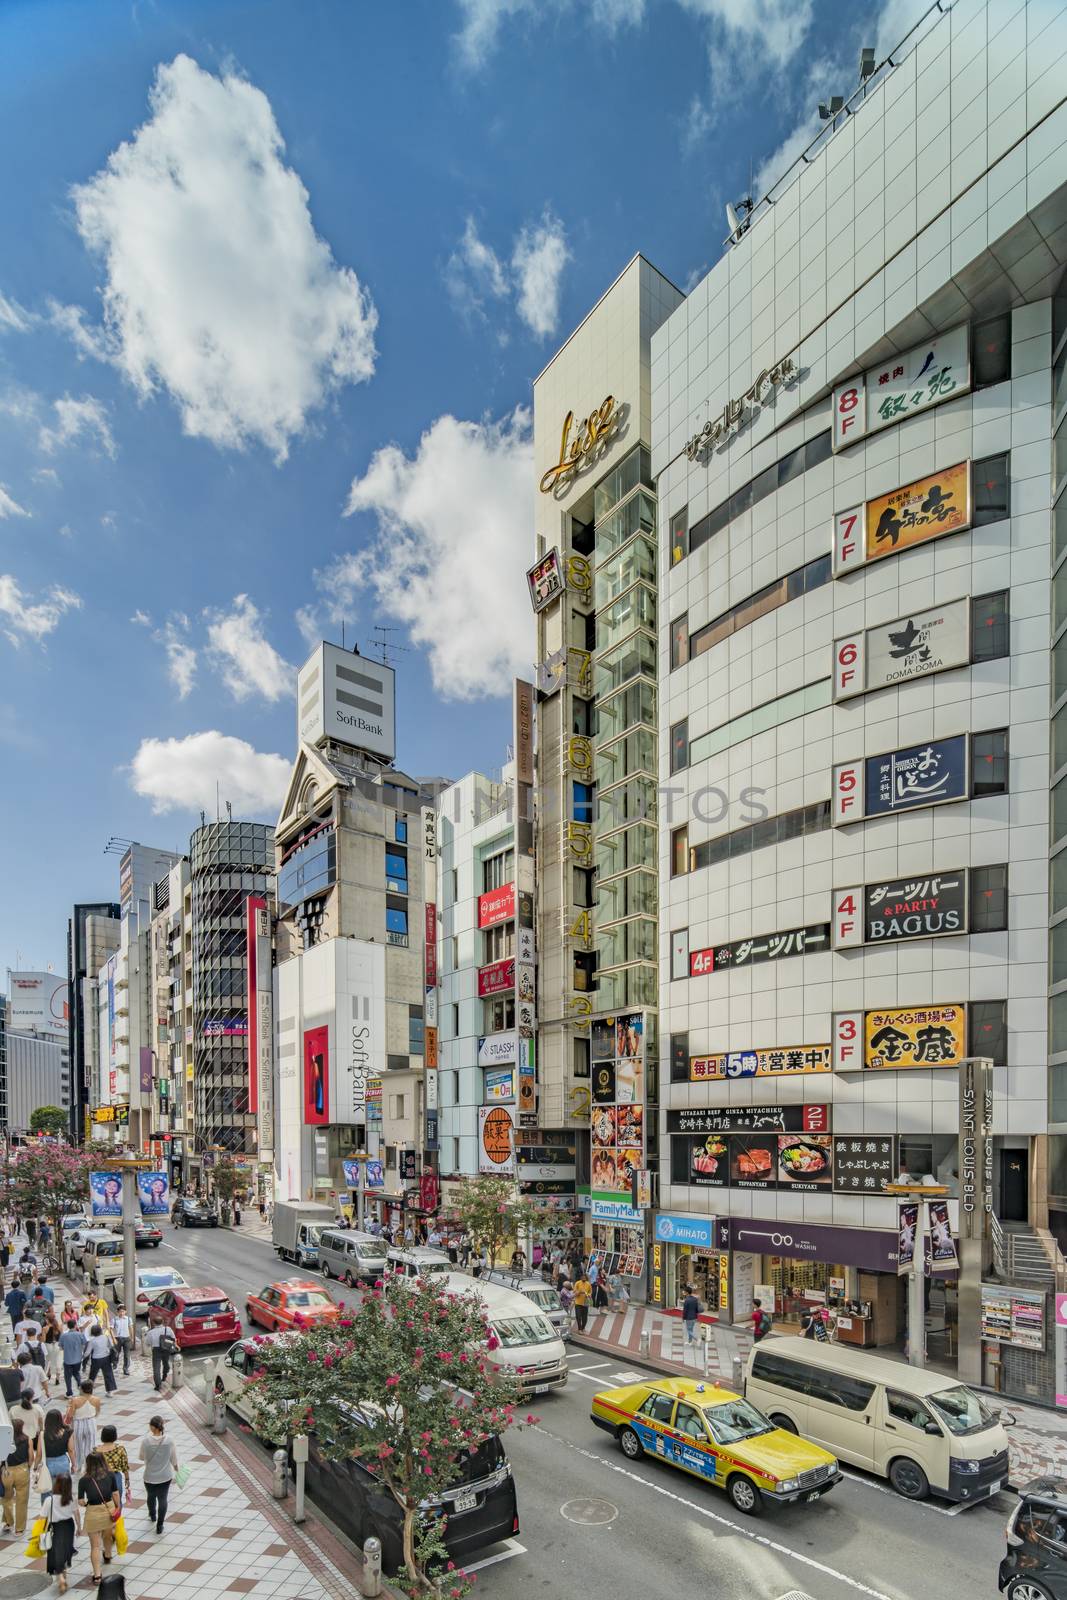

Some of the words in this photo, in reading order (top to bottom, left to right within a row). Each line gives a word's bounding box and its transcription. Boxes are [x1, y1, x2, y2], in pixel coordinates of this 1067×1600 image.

[878, 366, 904, 386] 焼肉
[839, 388, 859, 435] 8F
[840, 515, 858, 562] 7F
[568, 555, 592, 590] 8
[569, 647, 592, 682] 7
[838, 643, 858, 688] 6F
[886, 658, 944, 682] DOMA-DOMA
[336, 710, 384, 737] SoftBank
[568, 736, 592, 770] 6
[839, 770, 857, 814] 5F
[568, 822, 592, 856] 5
[869, 878, 960, 906] ダーツバー
[895, 898, 941, 915] PARTY
[569, 910, 592, 945] 4
[837, 895, 857, 938] 4F
[870, 910, 960, 939] BAGUS
[693, 953, 712, 972] 4F
[735, 930, 826, 964] ダーツバー
[570, 996, 592, 1028] 3
[872, 1010, 941, 1026] きんくら酒場
[838, 1019, 857, 1062] 3F
[870, 1025, 956, 1063] 金の蔵
[352, 1025, 370, 1113] SoftBank
[571, 1086, 591, 1117] 2
[963, 1089, 975, 1131] SAINT
[679, 1117, 730, 1130] 宮崎牛専門店
[807, 1107, 823, 1131] 2F
[836, 1142, 890, 1153] 鉄板焼き
[963, 1137, 975, 1180] LOUIS
[984, 1138, 993, 1181] LOUIS
[838, 1159, 890, 1170] しゃぶしゃぶ
[594, 1202, 641, 1217] FamilyMart
[963, 1185, 975, 1212] BLD
[984, 1186, 993, 1212] BLD
[676, 1228, 707, 1241] MIHATO
[795, 1243, 817, 1251] WASHIN
[720, 1257, 728, 1308] SALE
